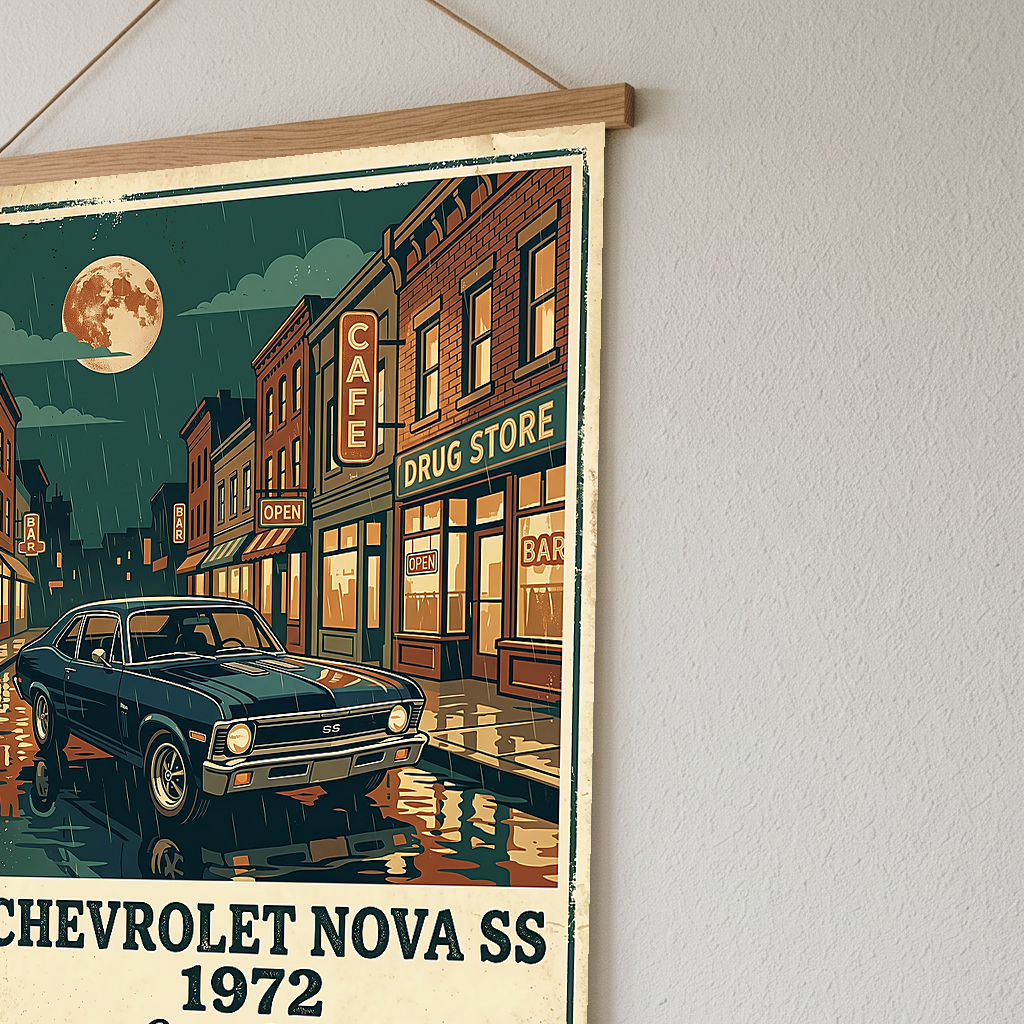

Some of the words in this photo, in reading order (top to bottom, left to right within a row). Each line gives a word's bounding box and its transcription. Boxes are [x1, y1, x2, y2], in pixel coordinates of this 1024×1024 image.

[345, 322, 371, 448] CAFE
[403, 439, 463, 489] DRUG
[468, 399, 555, 465] STORE
[175, 506, 184, 541] BAR
[263, 504, 302, 520] OPEN
[26, 517, 37, 552] BAR
[523, 535, 565, 563] BAR
[408, 554, 436, 572] OPEN
[322, 723, 341, 734] SS
[310, 905, 465, 962] NOVA
[480, 909, 547, 965] SS
[181, 964, 323, 1018] 1972
